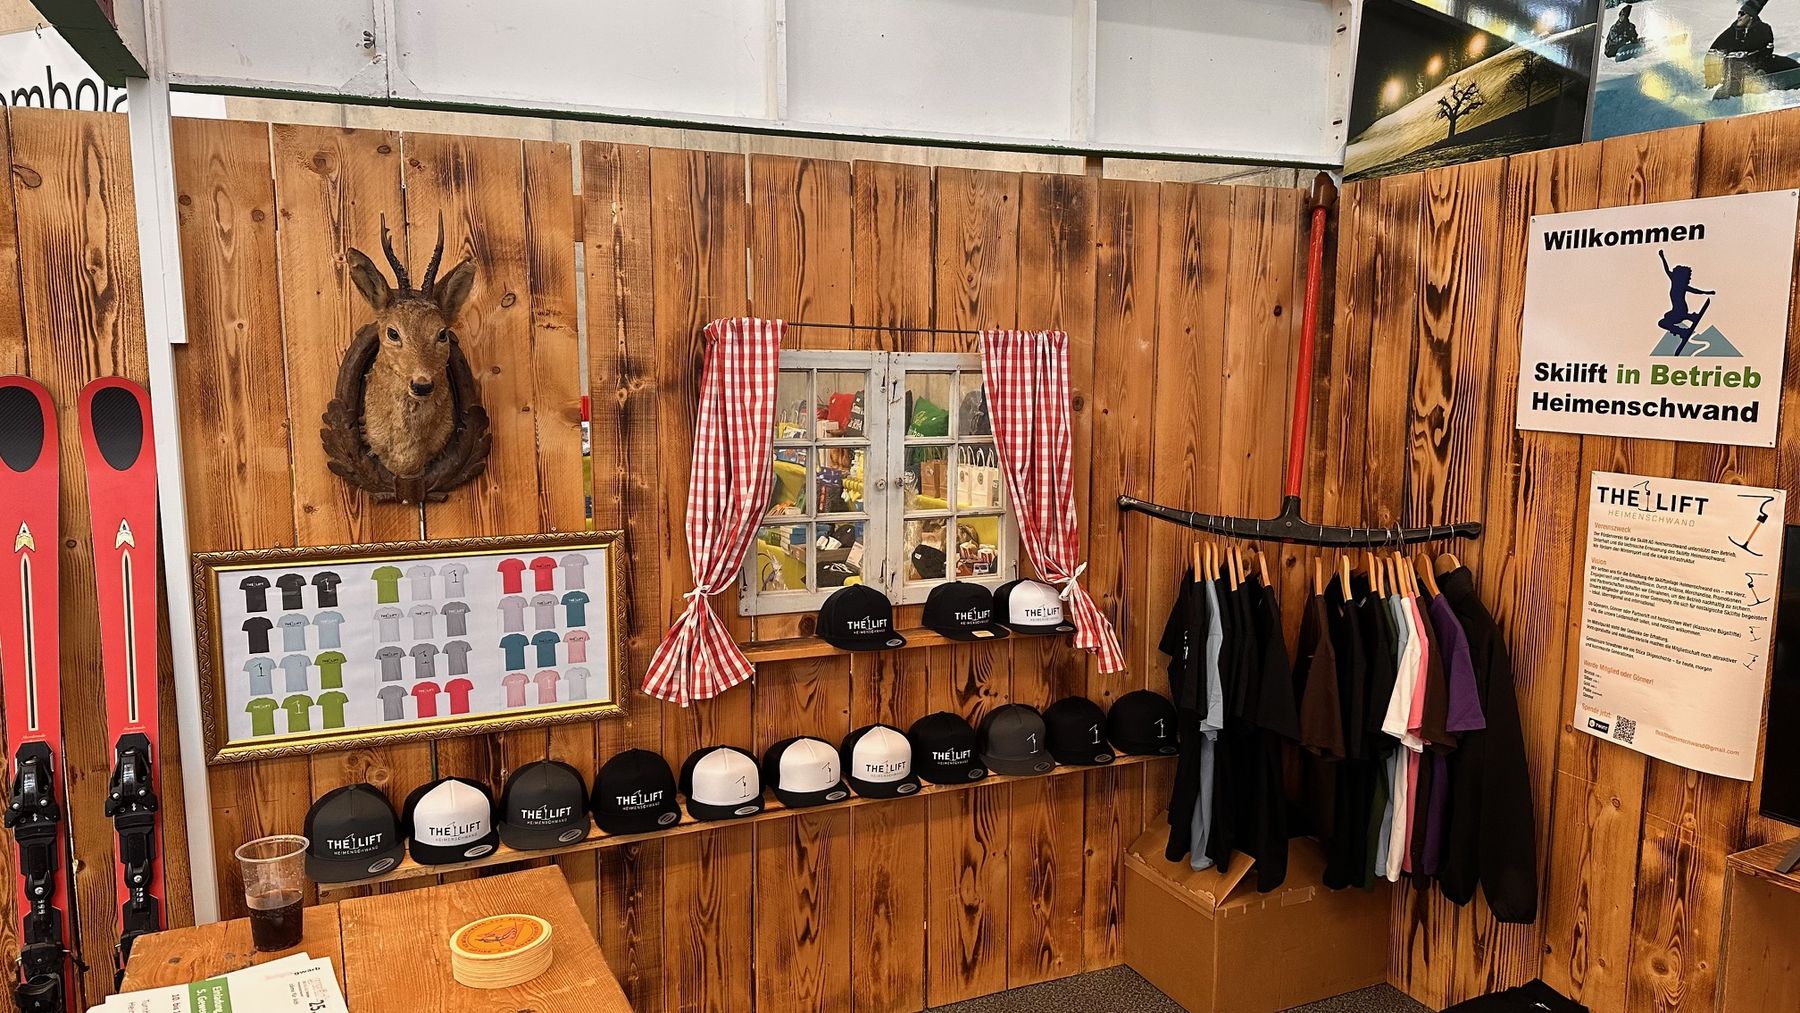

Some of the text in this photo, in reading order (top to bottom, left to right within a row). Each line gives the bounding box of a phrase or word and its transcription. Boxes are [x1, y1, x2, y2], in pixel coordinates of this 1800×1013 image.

[1543, 223, 1705, 251] Willkommen
[1534, 362, 1762, 388] Skilift in Betrieb
[1532, 391, 1759, 423] Heimenschwand
[1597, 486, 1709, 515] THE LIFT
[1608, 509, 1695, 527] HEIMENSCHWAND
[955, 610, 990, 620] THE LIFT
[1047, 607, 1060, 615] LIFT
[847, 619, 887, 629] THE LIFT
[932, 750, 971, 760] THE LIFT
[866, 761, 906, 773] THE LIFT
[616, 790, 663, 805] THE LIFT
[521, 807, 571, 819] THE LIFT
[429, 820, 481, 836] THE LIFT
[327, 833, 382, 849] THE LIFT
